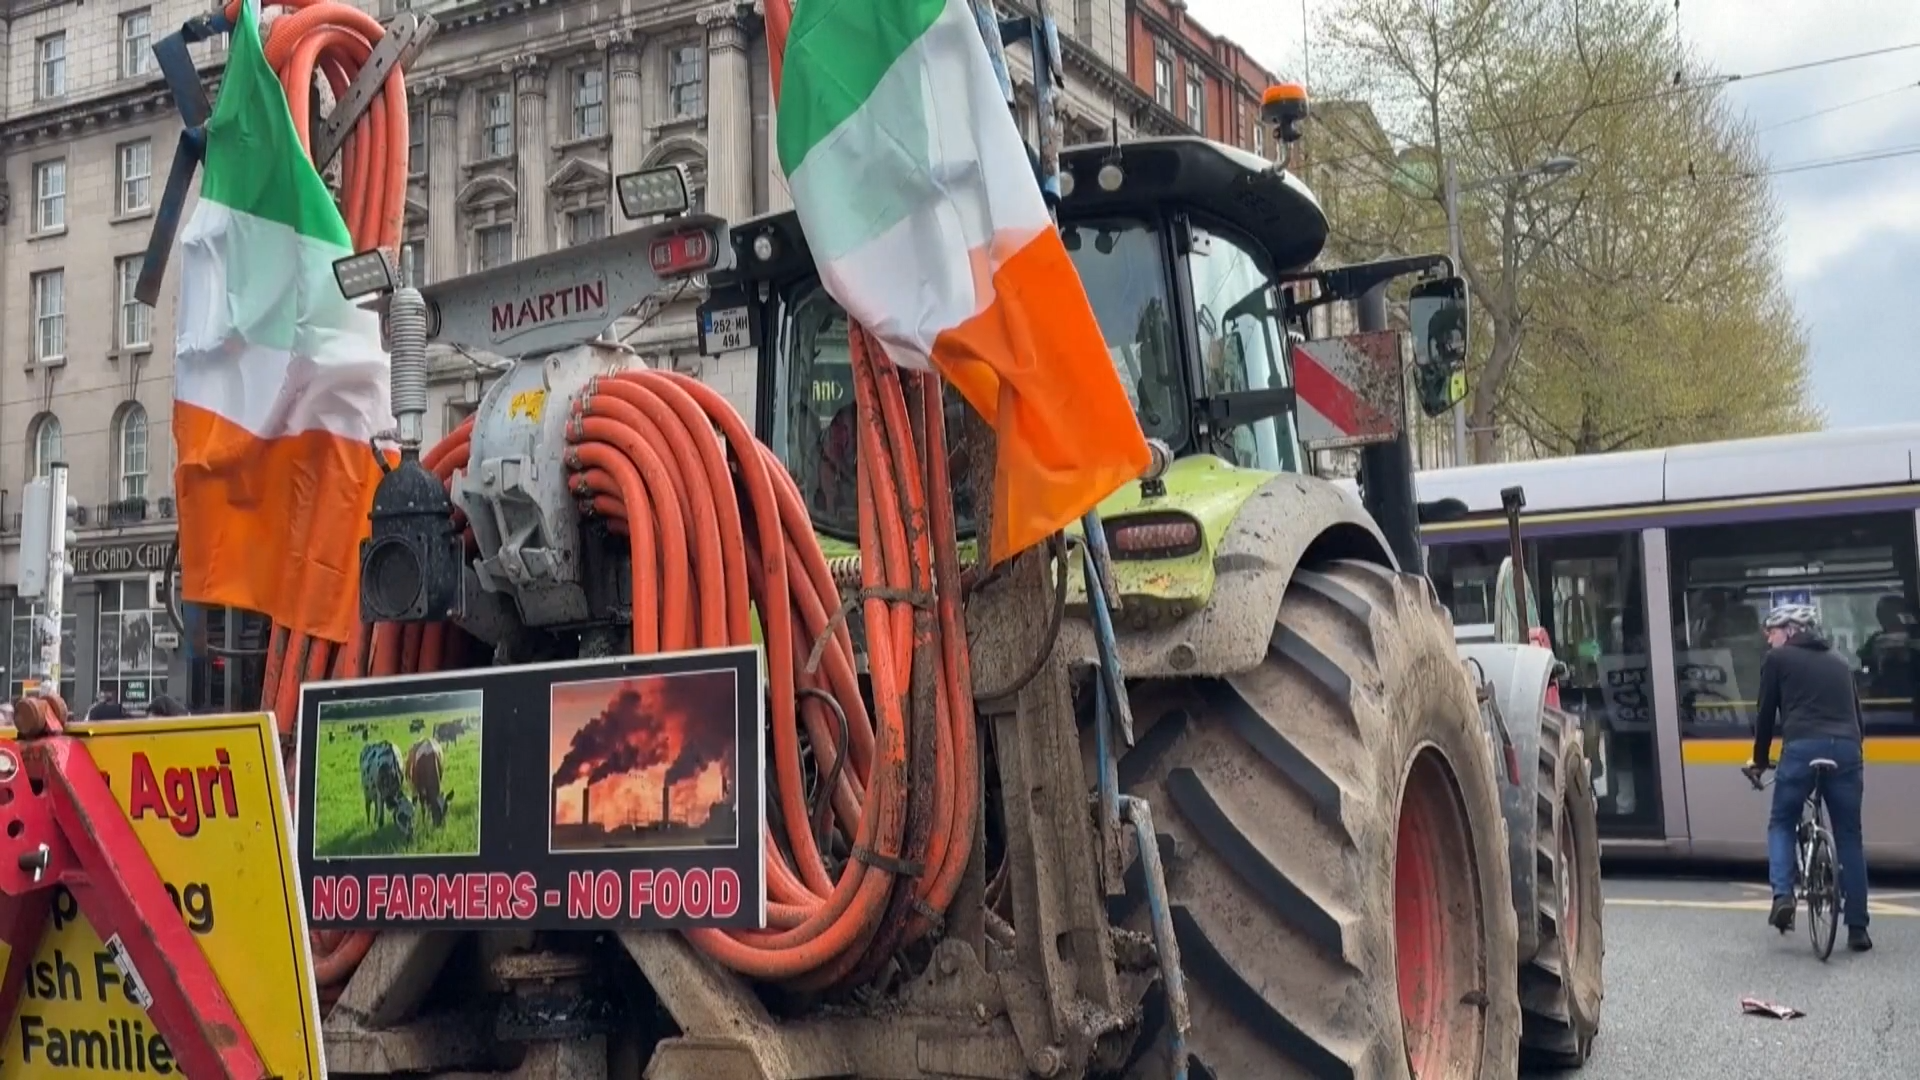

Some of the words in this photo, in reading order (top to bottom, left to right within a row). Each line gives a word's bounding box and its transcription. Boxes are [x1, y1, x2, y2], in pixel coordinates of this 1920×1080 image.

[491, 280, 604, 333] MARTIN
[722, 333, 740, 348] 494
[70, 547, 89, 572] THE
[92, 546, 132, 571] GRAND
[136, 543, 181, 568] CENT
[130, 748, 239, 837] Agri
[312, 874, 361, 921] NO
[366, 871, 538, 921] FARMERS
[567, 869, 622, 920] NO
[629, 867, 741, 920] FOOD
[20, 1014, 186, 1075] Familie
